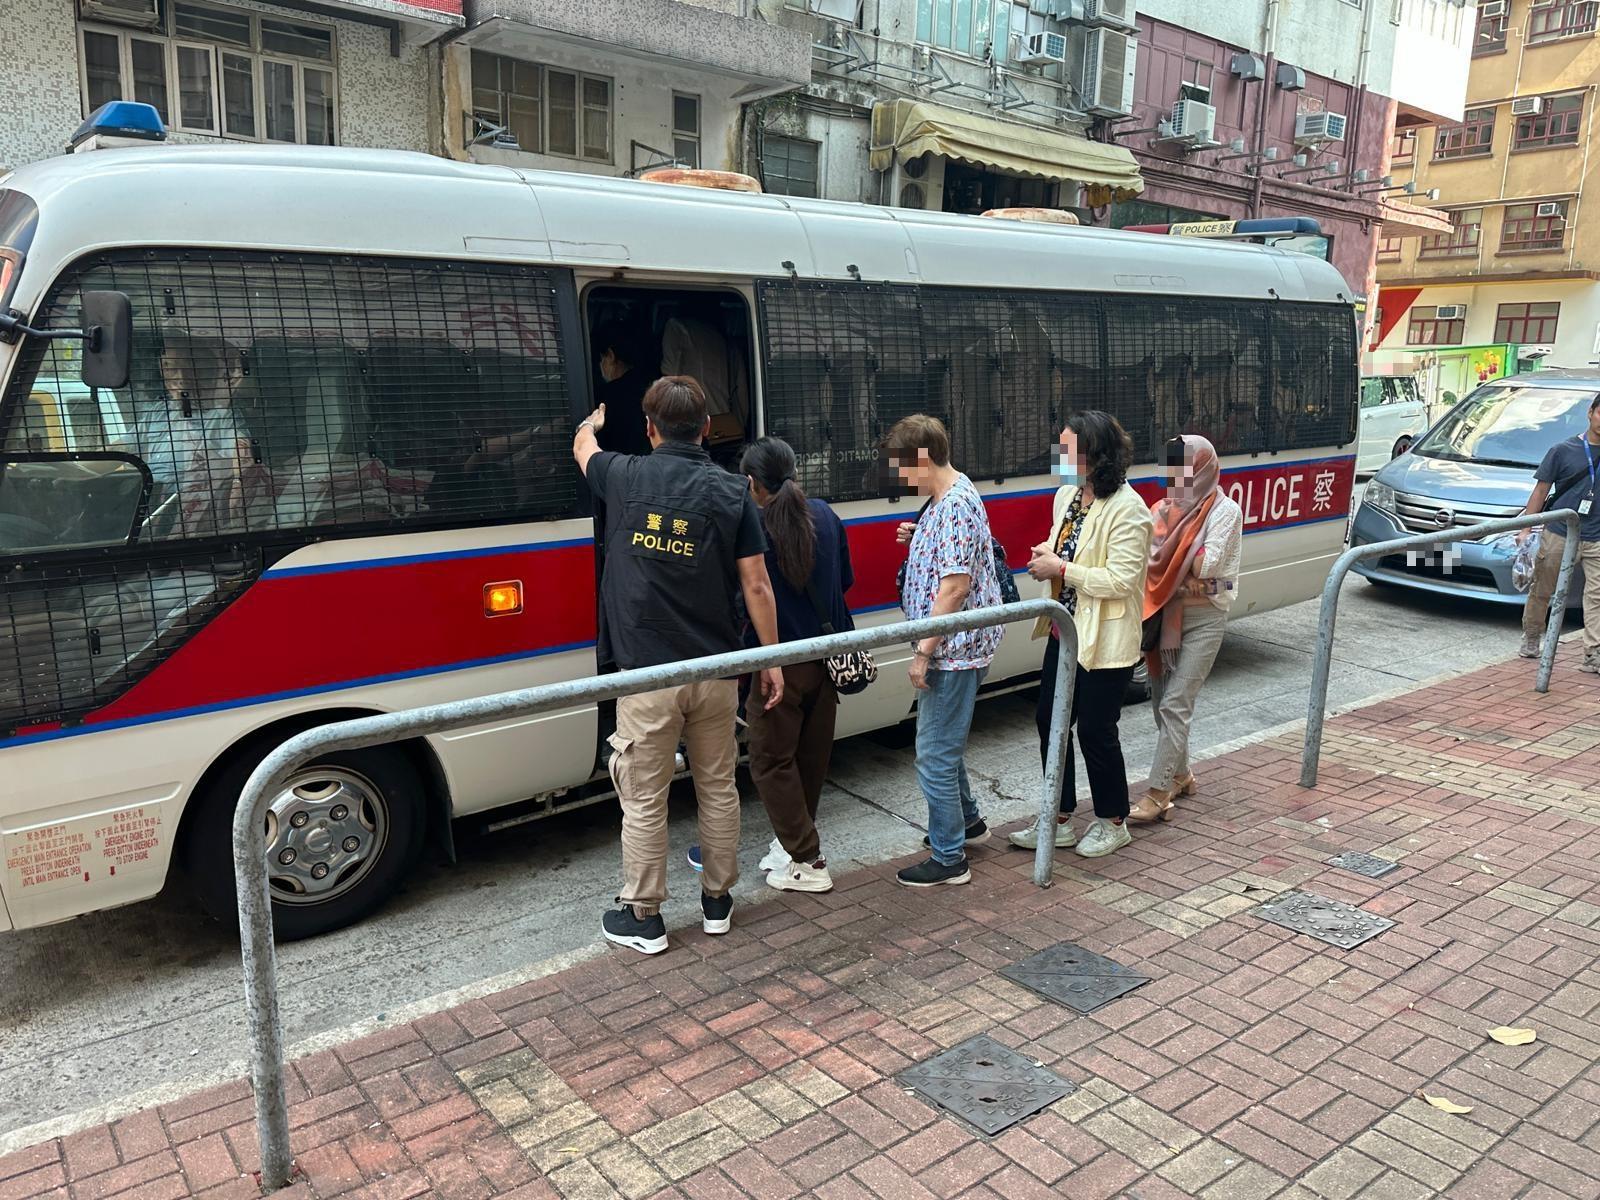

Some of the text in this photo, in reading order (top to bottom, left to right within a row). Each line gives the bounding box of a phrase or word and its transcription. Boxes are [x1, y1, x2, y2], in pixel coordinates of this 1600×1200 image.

[1185, 225, 1217, 233] POLICE
[1312, 469, 1335, 512] 察
[646, 513, 689, 535] 警察
[632, 532, 695, 556] POLICE
